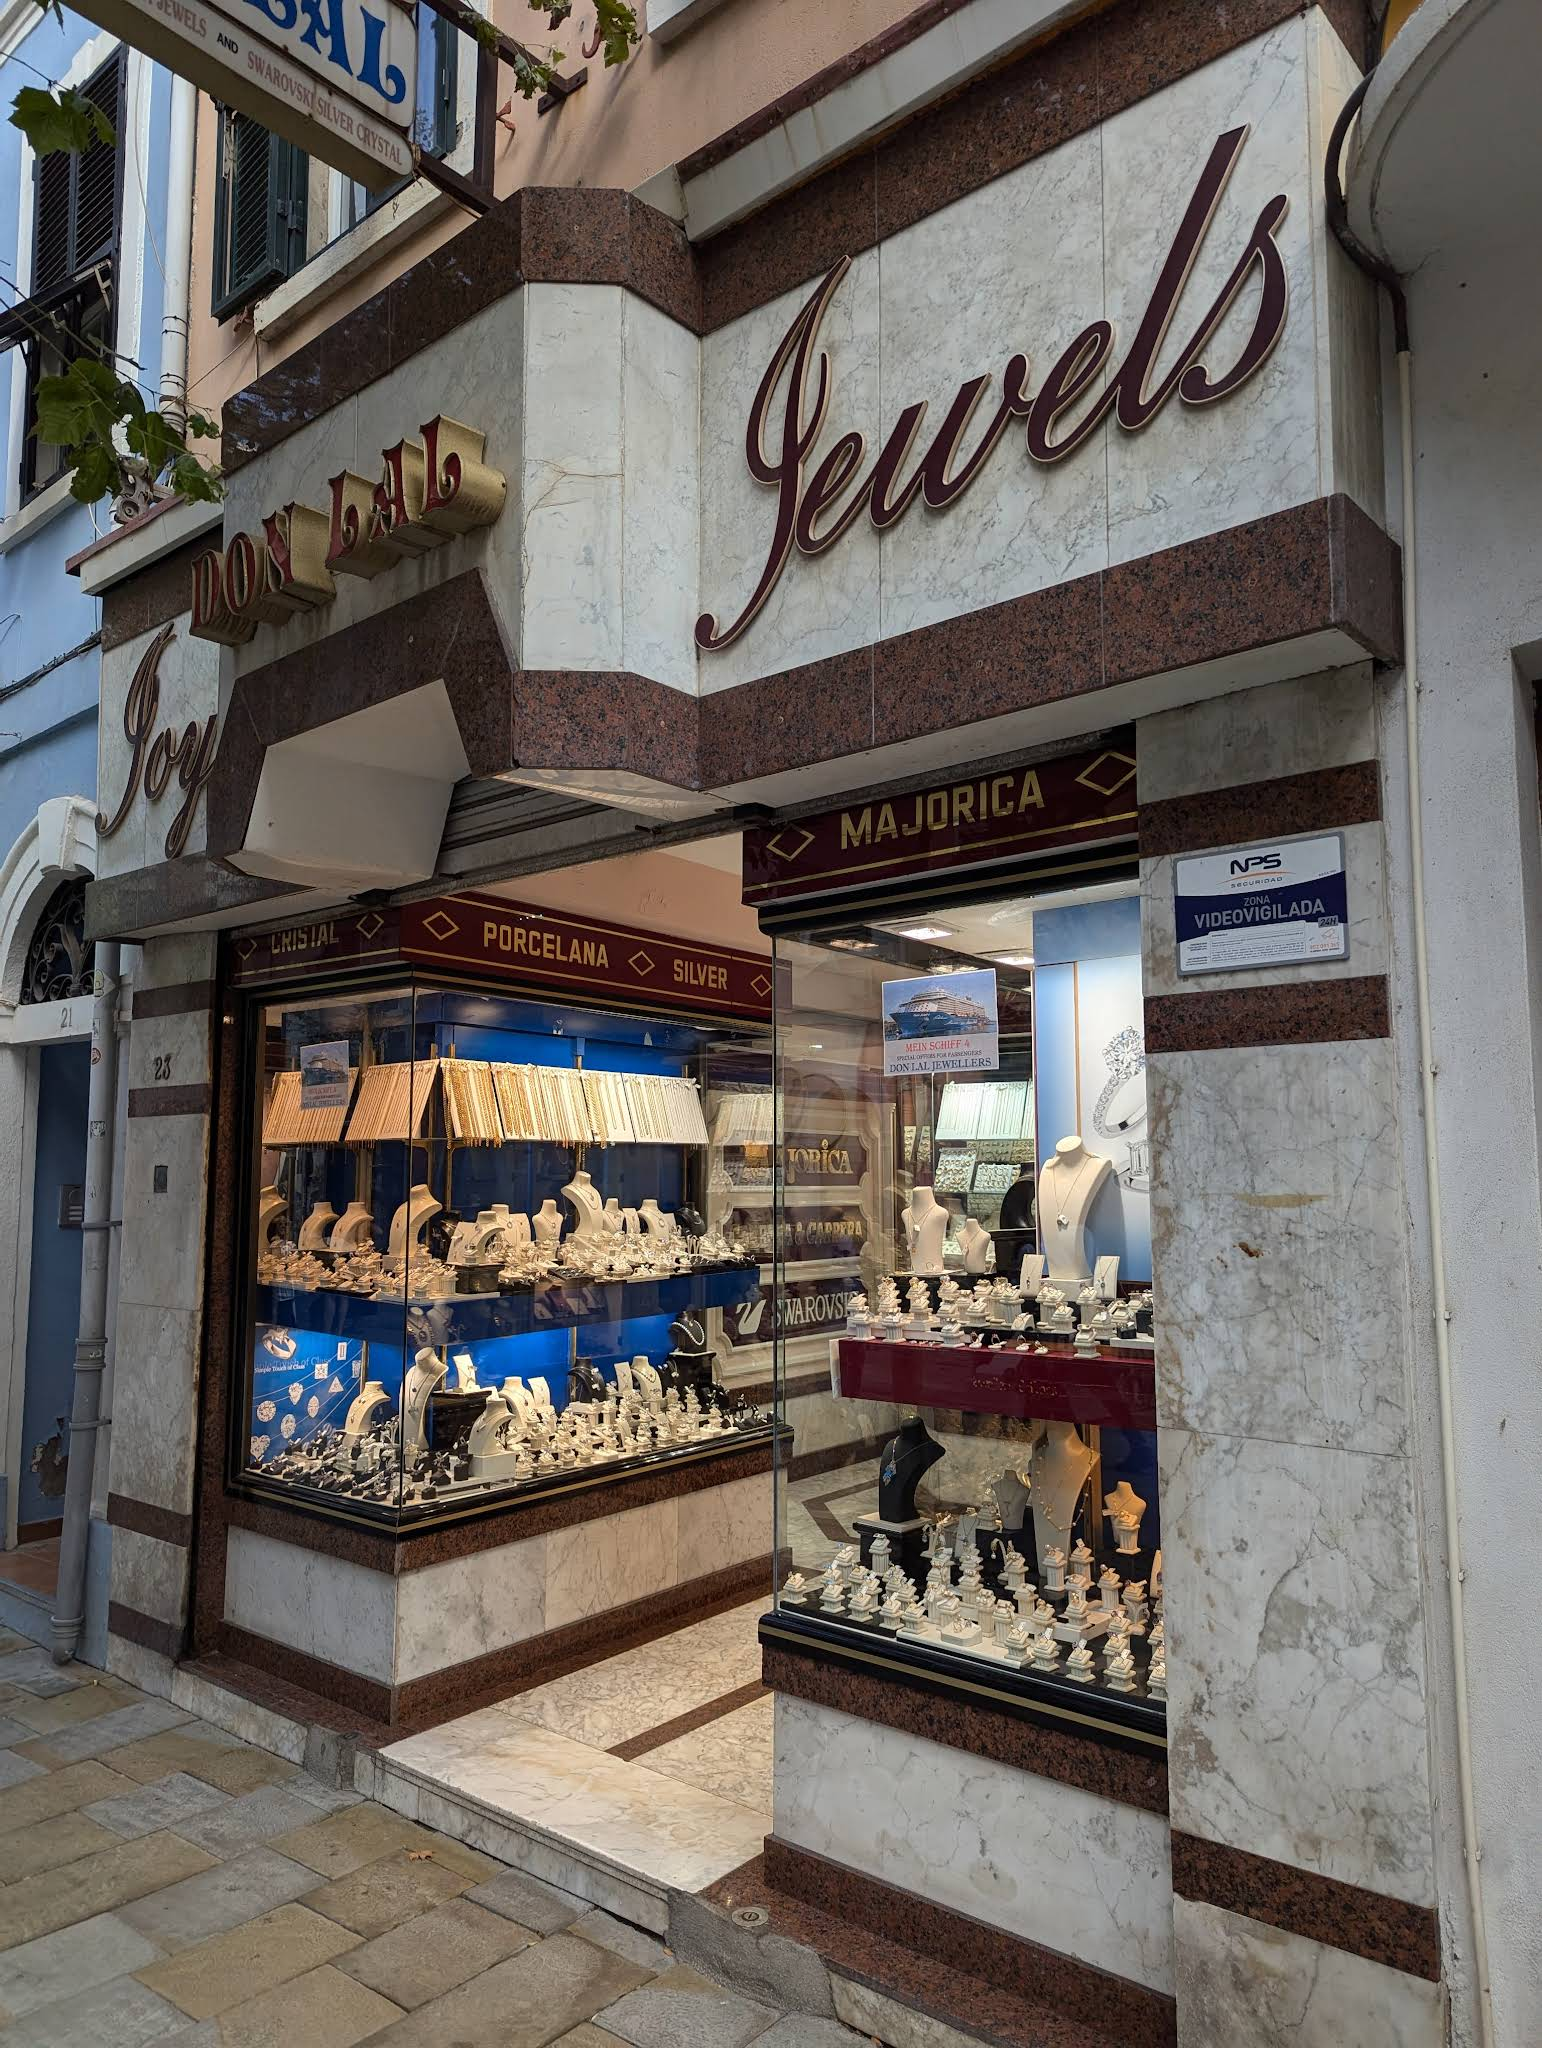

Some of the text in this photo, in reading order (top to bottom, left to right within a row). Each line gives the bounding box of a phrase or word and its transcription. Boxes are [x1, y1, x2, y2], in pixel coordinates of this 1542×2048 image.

[216, 32, 239, 54] AND
[247, 51, 315, 109] SWAROVSKI
[316, 98, 353, 132] SILVER
[356, 124, 403, 166] CRYSTAL
[694, 122, 1289, 652] Jewels
[190, 414, 489, 643] DON LAL
[840, 769, 1046, 850] MAJORICA
[1230, 853, 1282, 875] NPS
[1194, 898, 1326, 929] VIDEOVIGILADA
[1244, 895, 1271, 907] ZONA
[271, 920, 340, 954] CRISTAL
[1320, 916, 1337, 927] 24H
[482, 921, 728, 991] PORCELANA SILVER
[60, 1007, 73, 1028] 21
[905, 1042, 927, 1053] MEIN
[929, 1039, 962, 1051] SCHIFF
[153, 1054, 171, 1081] 23
[889, 1058, 992, 1073] DON LAL JEWELLERS
[771, 1291, 861, 1328] SWAROVSK
